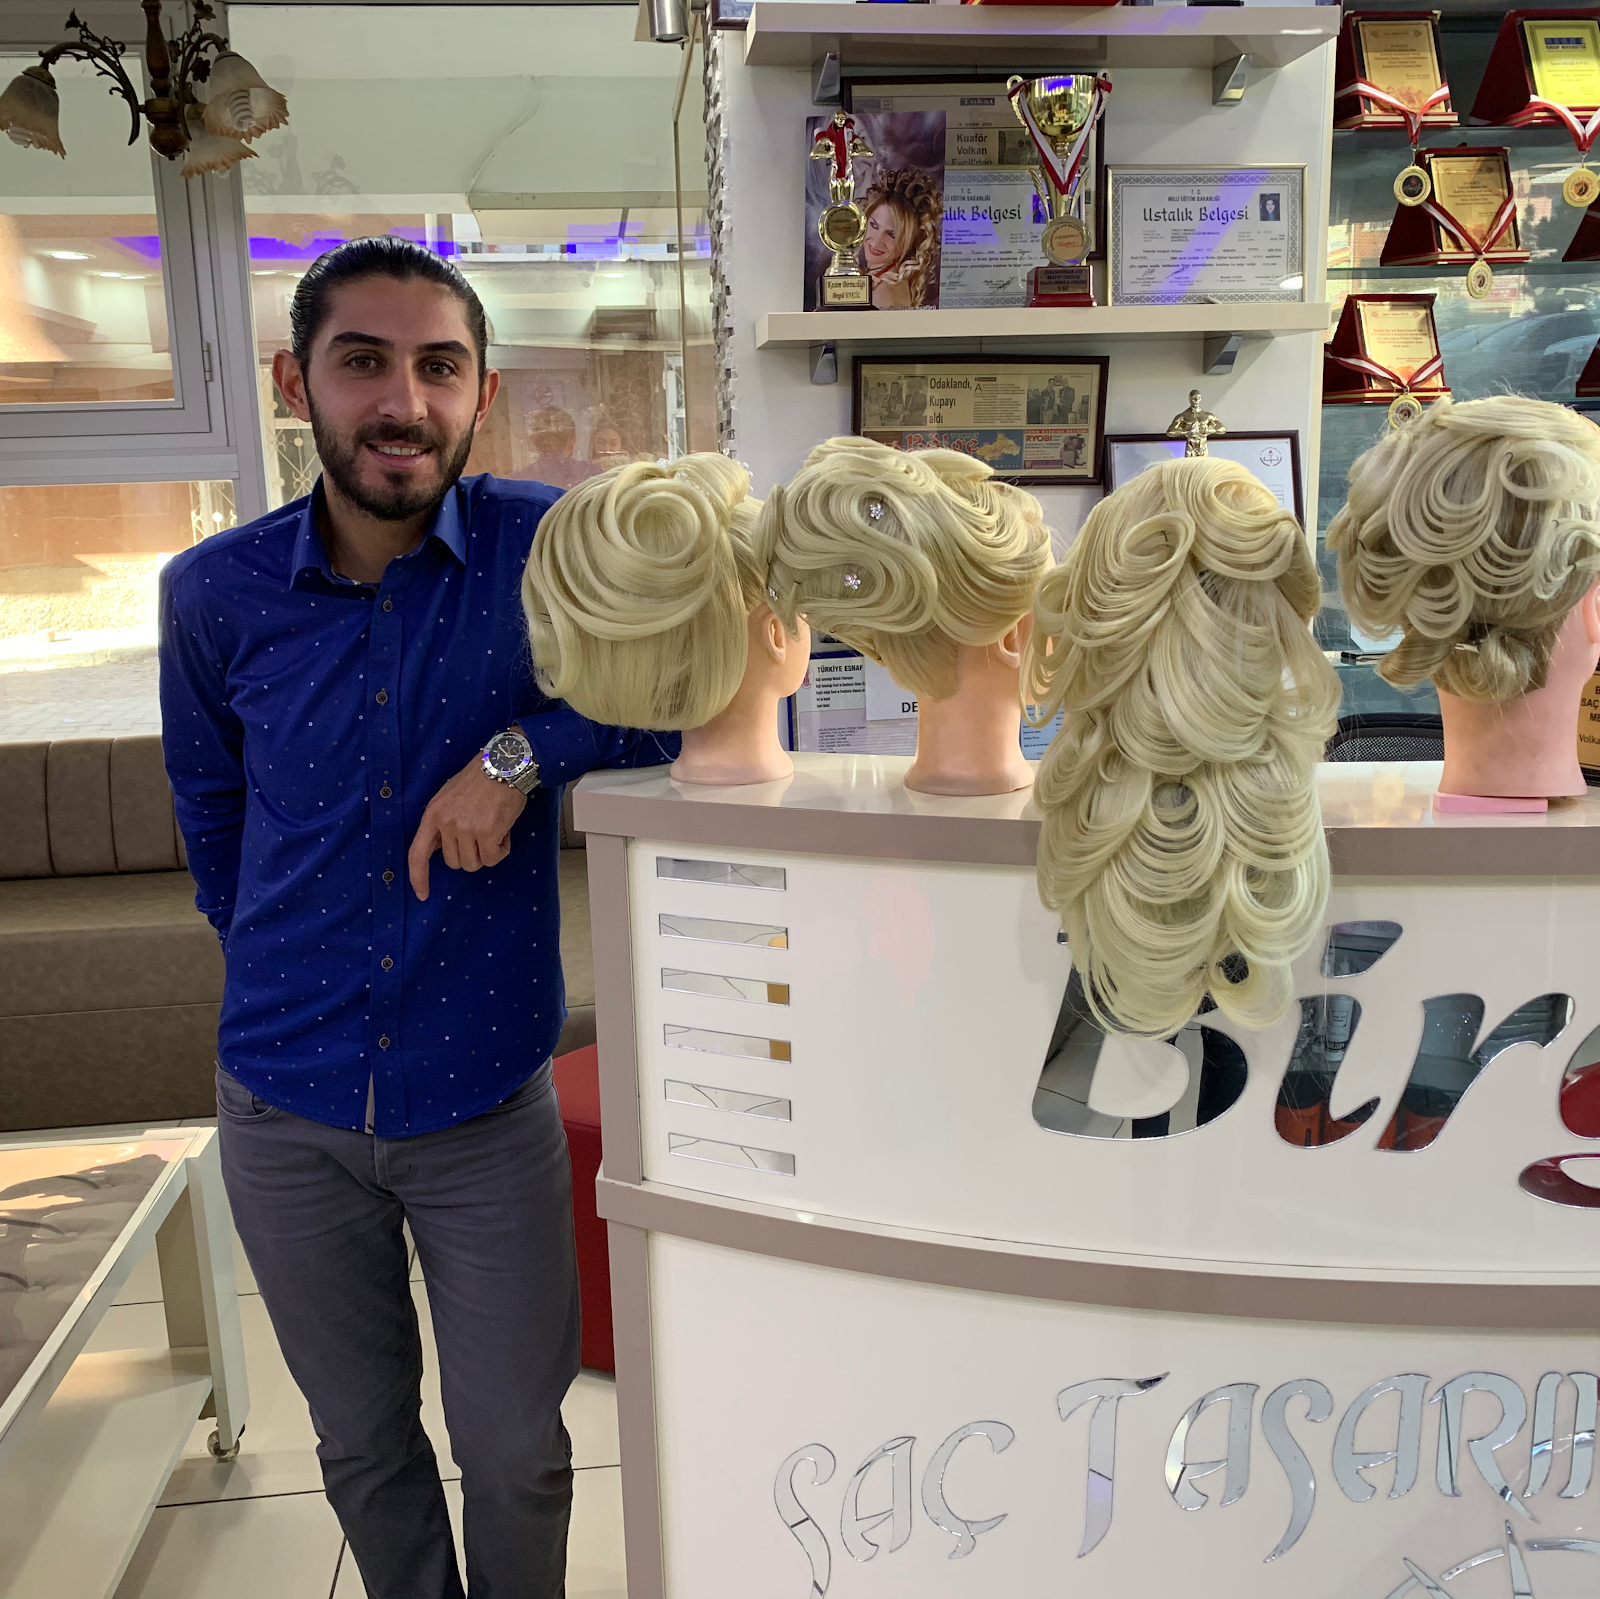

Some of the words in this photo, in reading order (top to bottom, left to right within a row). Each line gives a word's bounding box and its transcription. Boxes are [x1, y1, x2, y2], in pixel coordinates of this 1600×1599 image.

[956, 133, 988, 143] Kuaför
[956, 146, 988, 155] Volkan
[970, 203, 1022, 225] Belgesi
[1143, 207, 1194, 222] Ustalık
[1199, 206, 1249, 225] Belgesi
[929, 377, 973, 391] Odaklandı,
[929, 395, 957, 409] Kupayı
[928, 412, 944, 424] aldı
[1025, 434, 1053, 442] RYOBI
[817, 664, 843, 673] TÜRKİYE
[844, 664, 864, 672] ESNAF
[1580, 697, 1600, 710] SAÇ
